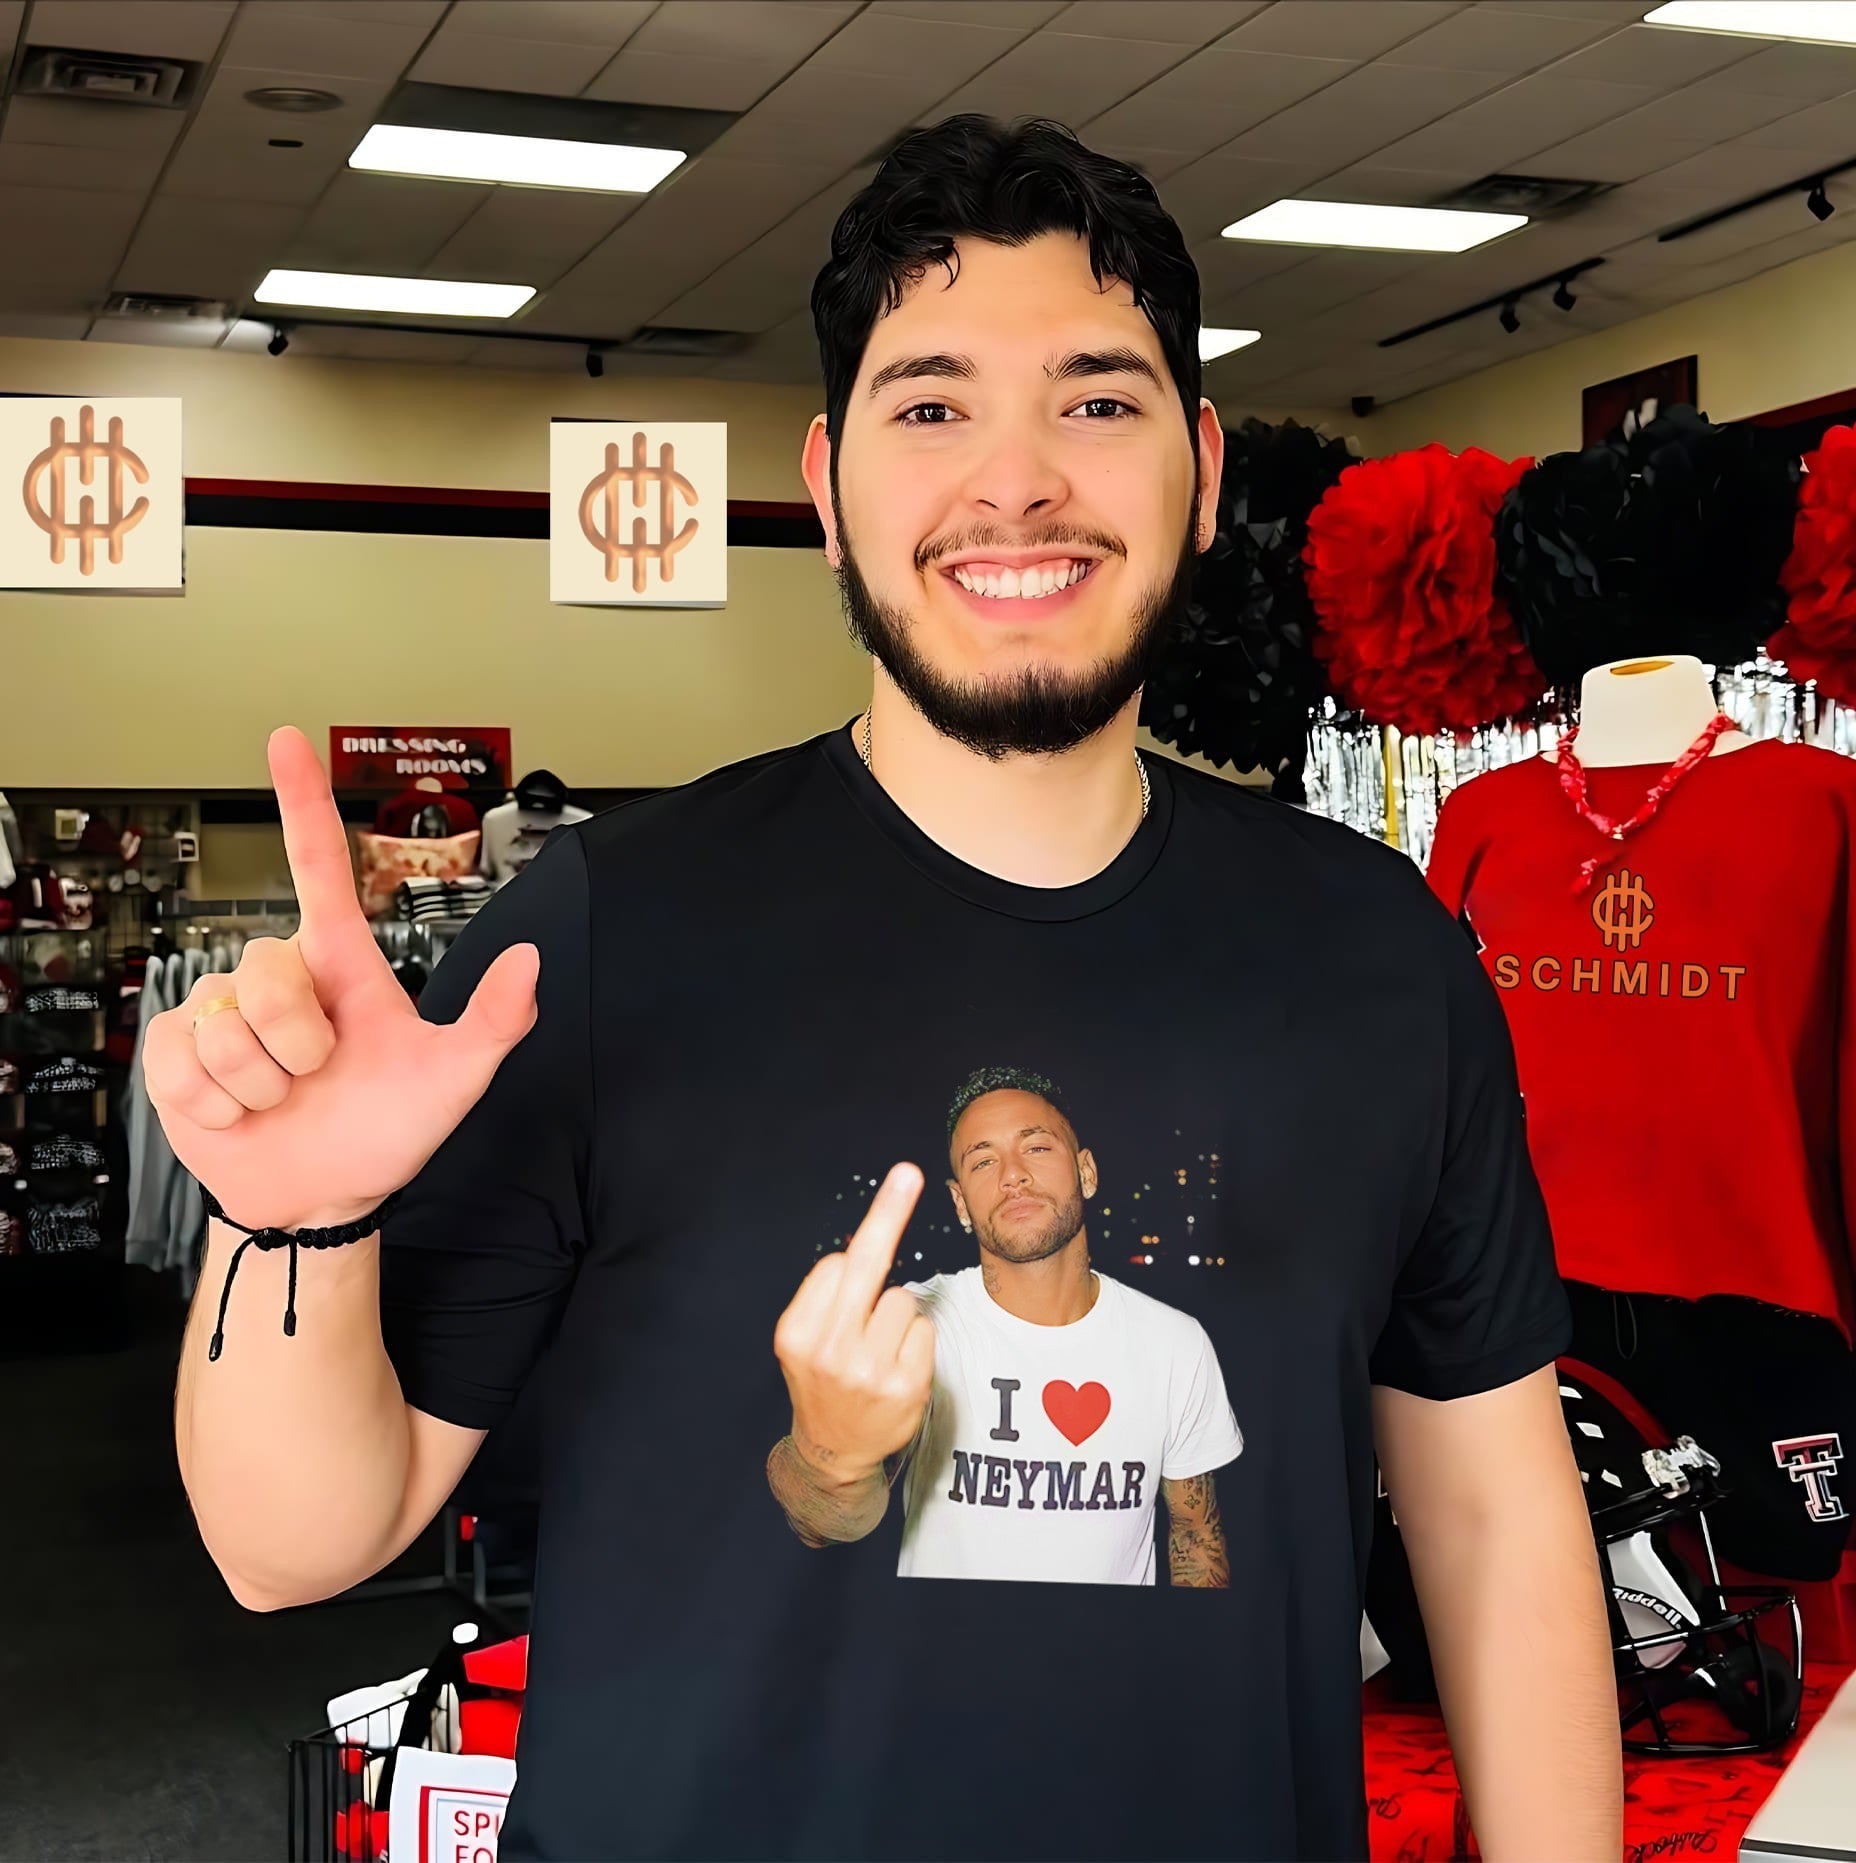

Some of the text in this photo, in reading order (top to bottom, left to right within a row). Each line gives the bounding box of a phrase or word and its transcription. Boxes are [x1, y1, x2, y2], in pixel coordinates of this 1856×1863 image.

[396, 758, 487, 774] ROOMS
[1494, 954, 1746, 1000] SCHMIDT
[990, 1377, 1021, 1442] I
[948, 1449, 1146, 1511] NEYMAR
